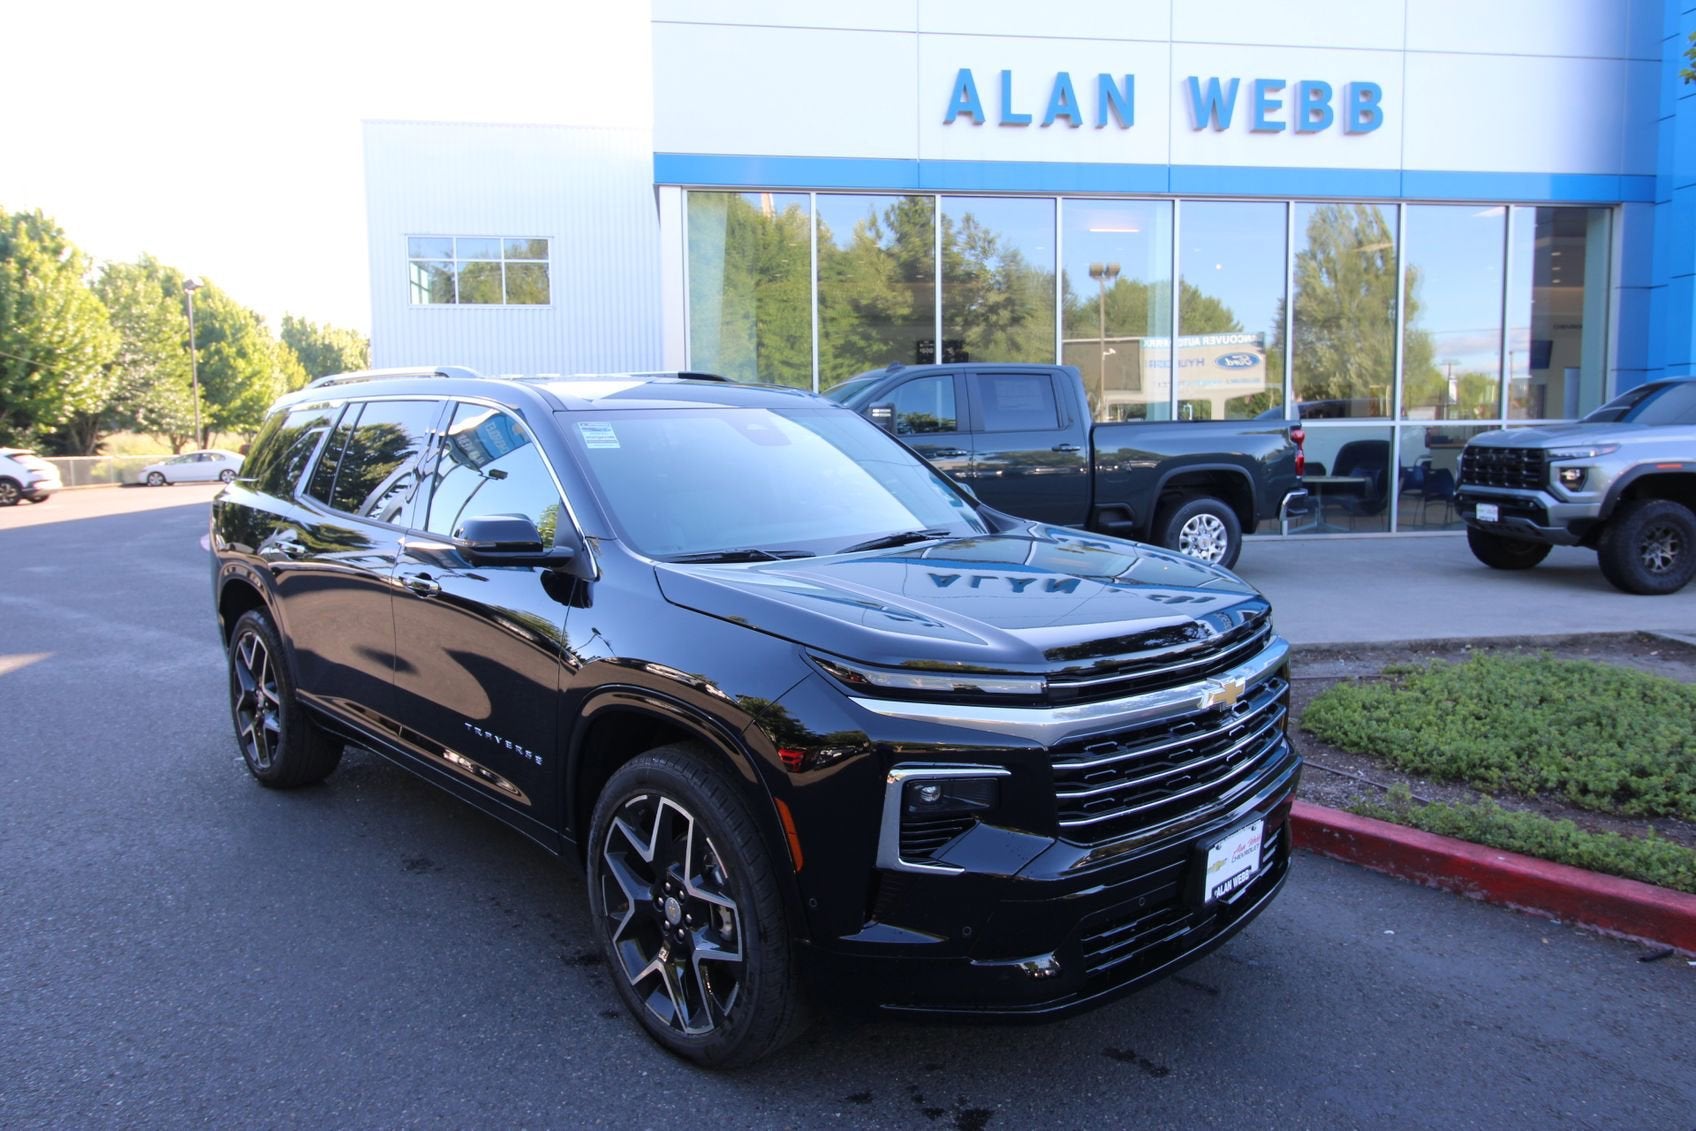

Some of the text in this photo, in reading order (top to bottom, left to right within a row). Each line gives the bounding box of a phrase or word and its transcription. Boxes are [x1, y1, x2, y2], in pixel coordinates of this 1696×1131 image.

[943, 67, 1384, 136] ALAN WEBB
[464, 722, 543, 767] TRAVERSE
[1216, 870, 1250, 898] ALAN WEBB
